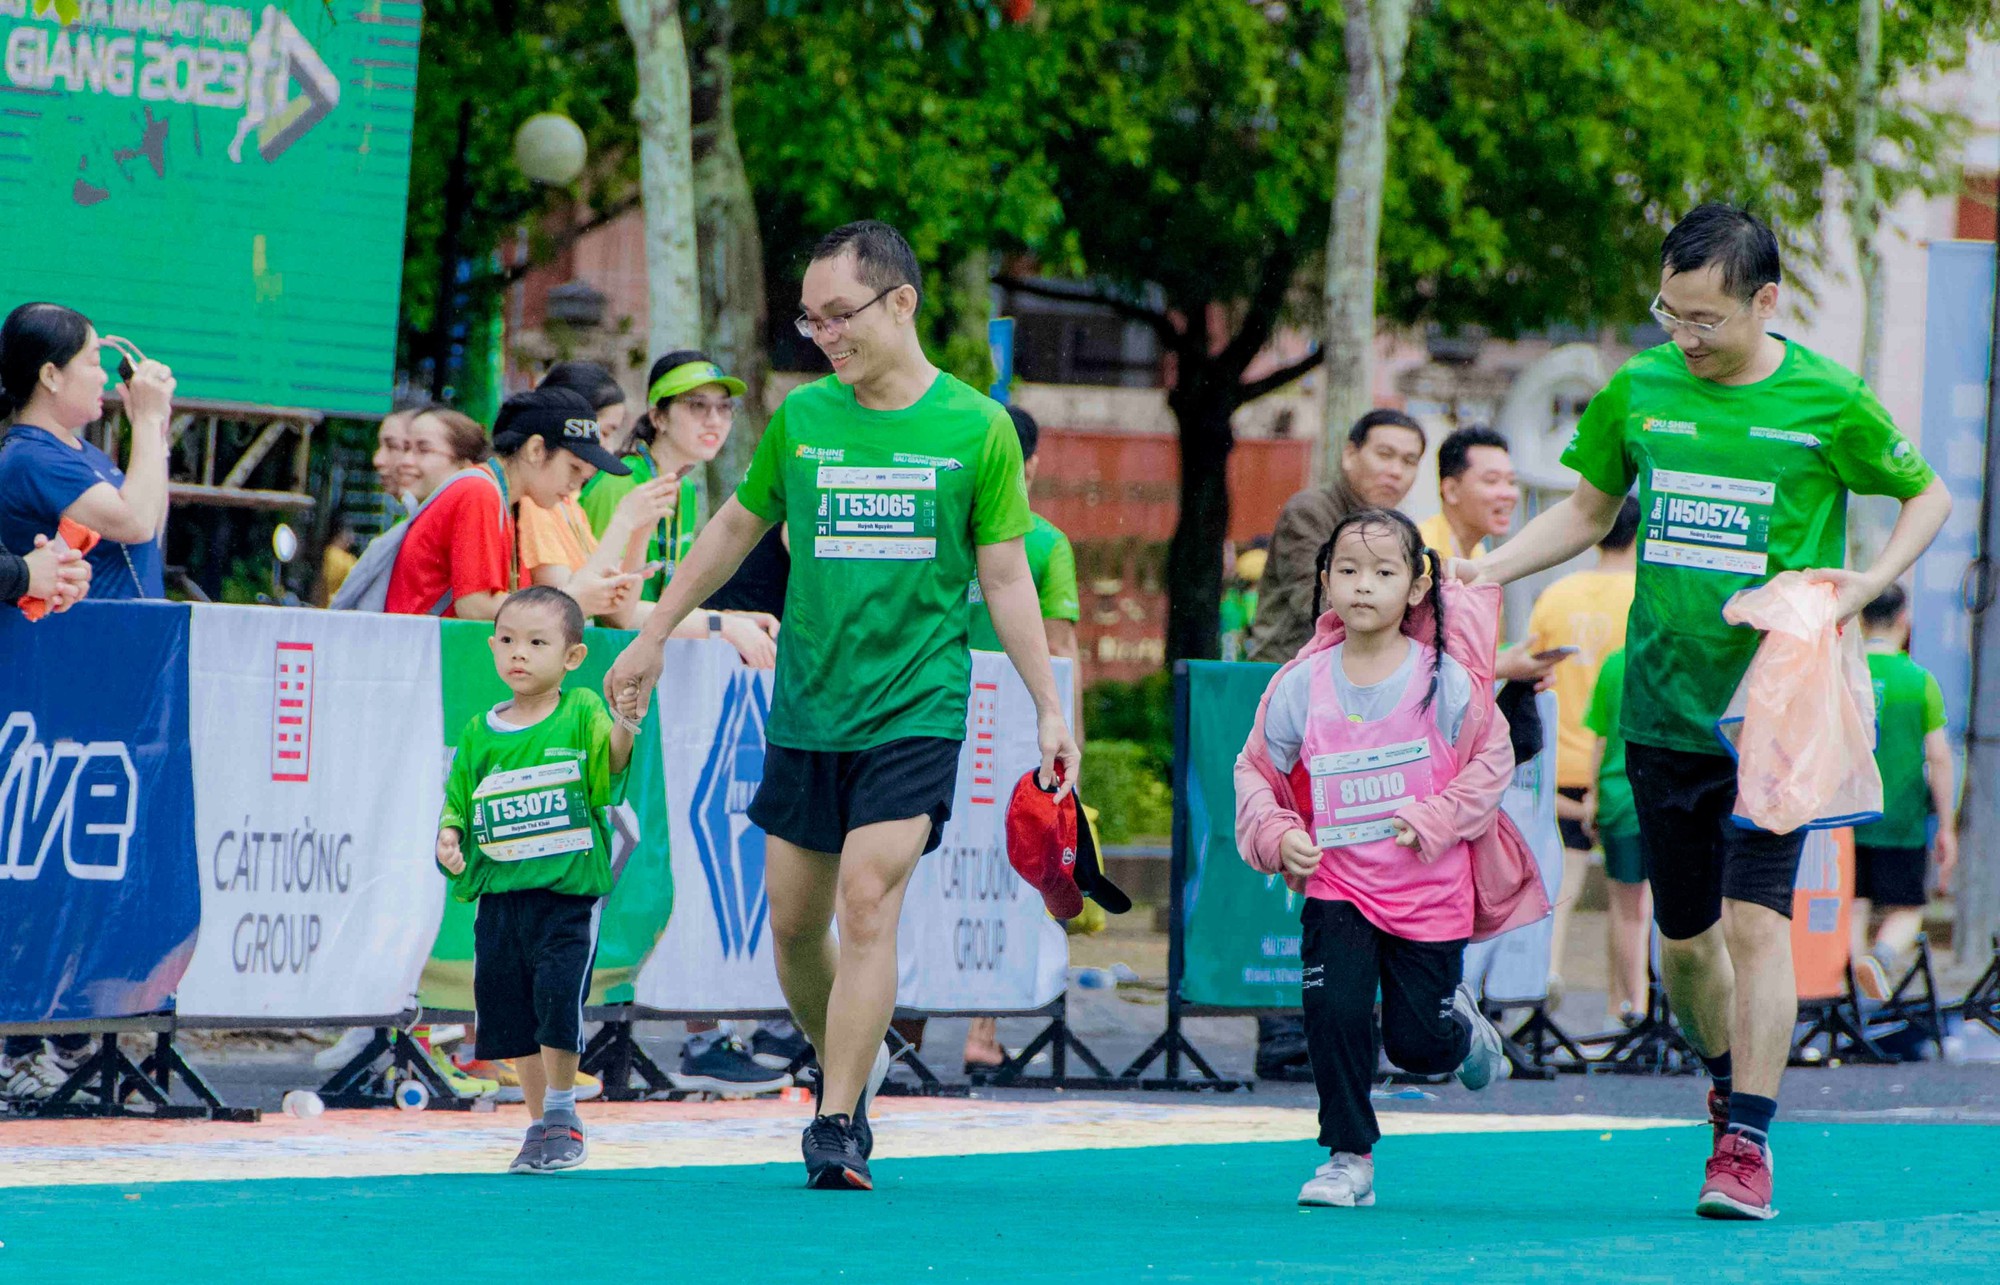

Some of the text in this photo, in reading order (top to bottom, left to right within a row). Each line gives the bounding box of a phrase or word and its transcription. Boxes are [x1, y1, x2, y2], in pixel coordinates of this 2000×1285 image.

[113, 0, 252, 43] MARATHON
[4, 27, 247, 109] GIANG 2023
[818, 494, 828, 516] 5km
[836, 493, 915, 517] T53065
[1667, 498, 1751, 530] H50574
[818, 525, 826, 535] M
[1650, 529, 1659, 538] M
[1314, 779, 1326, 811] 800m
[1340, 772, 1406, 804] 81010
[488, 788, 567, 822] T53073
[477, 834, 487, 844] M
[232, 912, 321, 974] GROUP
[954, 917, 1006, 970] GROUP
